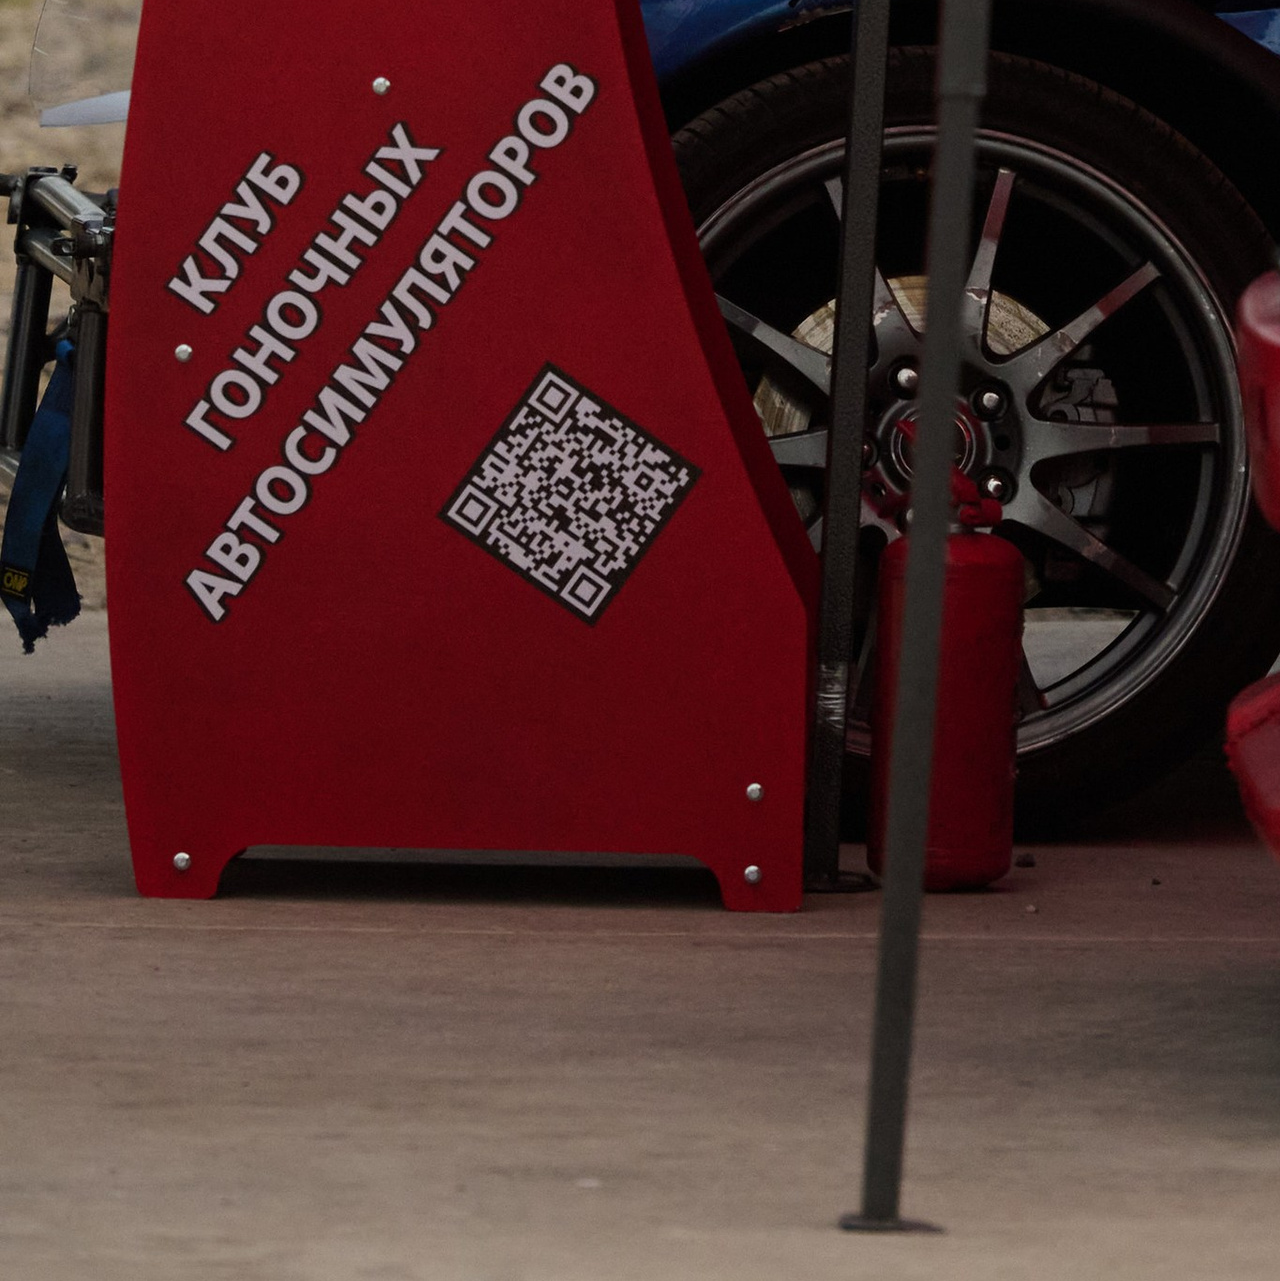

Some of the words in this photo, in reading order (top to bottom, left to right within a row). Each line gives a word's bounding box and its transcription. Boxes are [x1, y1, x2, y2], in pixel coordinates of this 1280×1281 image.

[167, 151, 302, 315] КЛУБ
[185, 122, 441, 451] ГОНОЧНЫХ
[185, 62, 597, 622] АВТОСИМУЛЯТОРОВ
